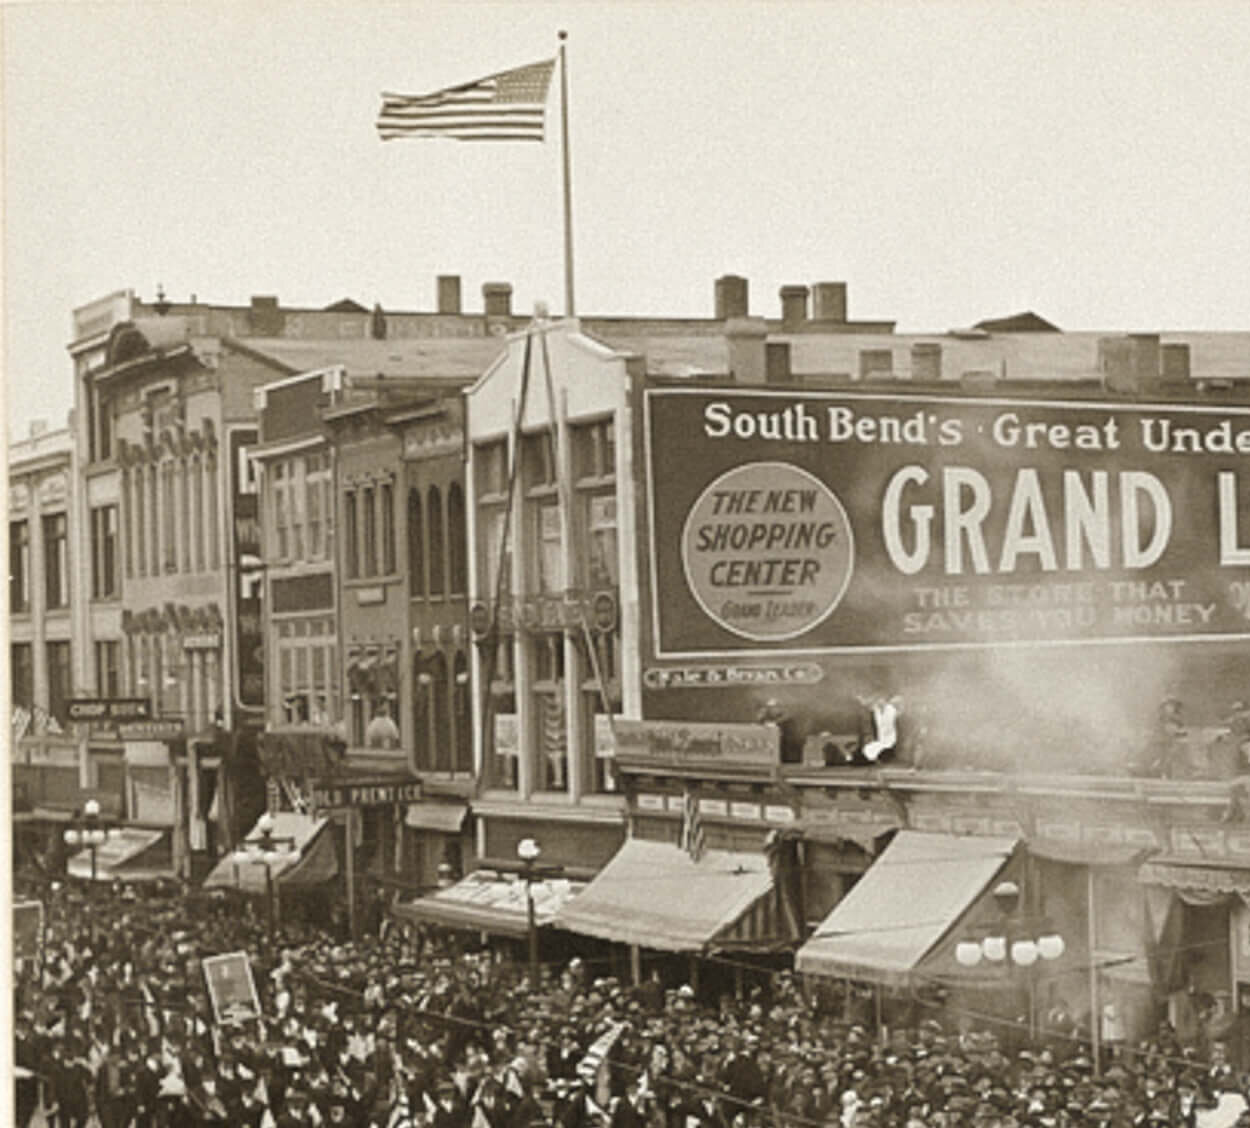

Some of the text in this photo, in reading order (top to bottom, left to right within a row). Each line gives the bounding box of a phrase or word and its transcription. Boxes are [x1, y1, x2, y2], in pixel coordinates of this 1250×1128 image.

[703, 403, 818, 441] South
[828, 407, 963, 446] Bend's
[993, 413, 1121, 449] Great
[711, 489, 817, 516] THE NEW
[882, 465, 1174, 576] GRAND
[696, 522, 837, 553] SHOPPING
[710, 558, 821, 588] CENTER
[913, 587, 970, 608] THE
[1107, 579, 1188, 602] THAT
[903, 610, 1019, 633] SAVES
[1113, 602, 1217, 627] MONEY
